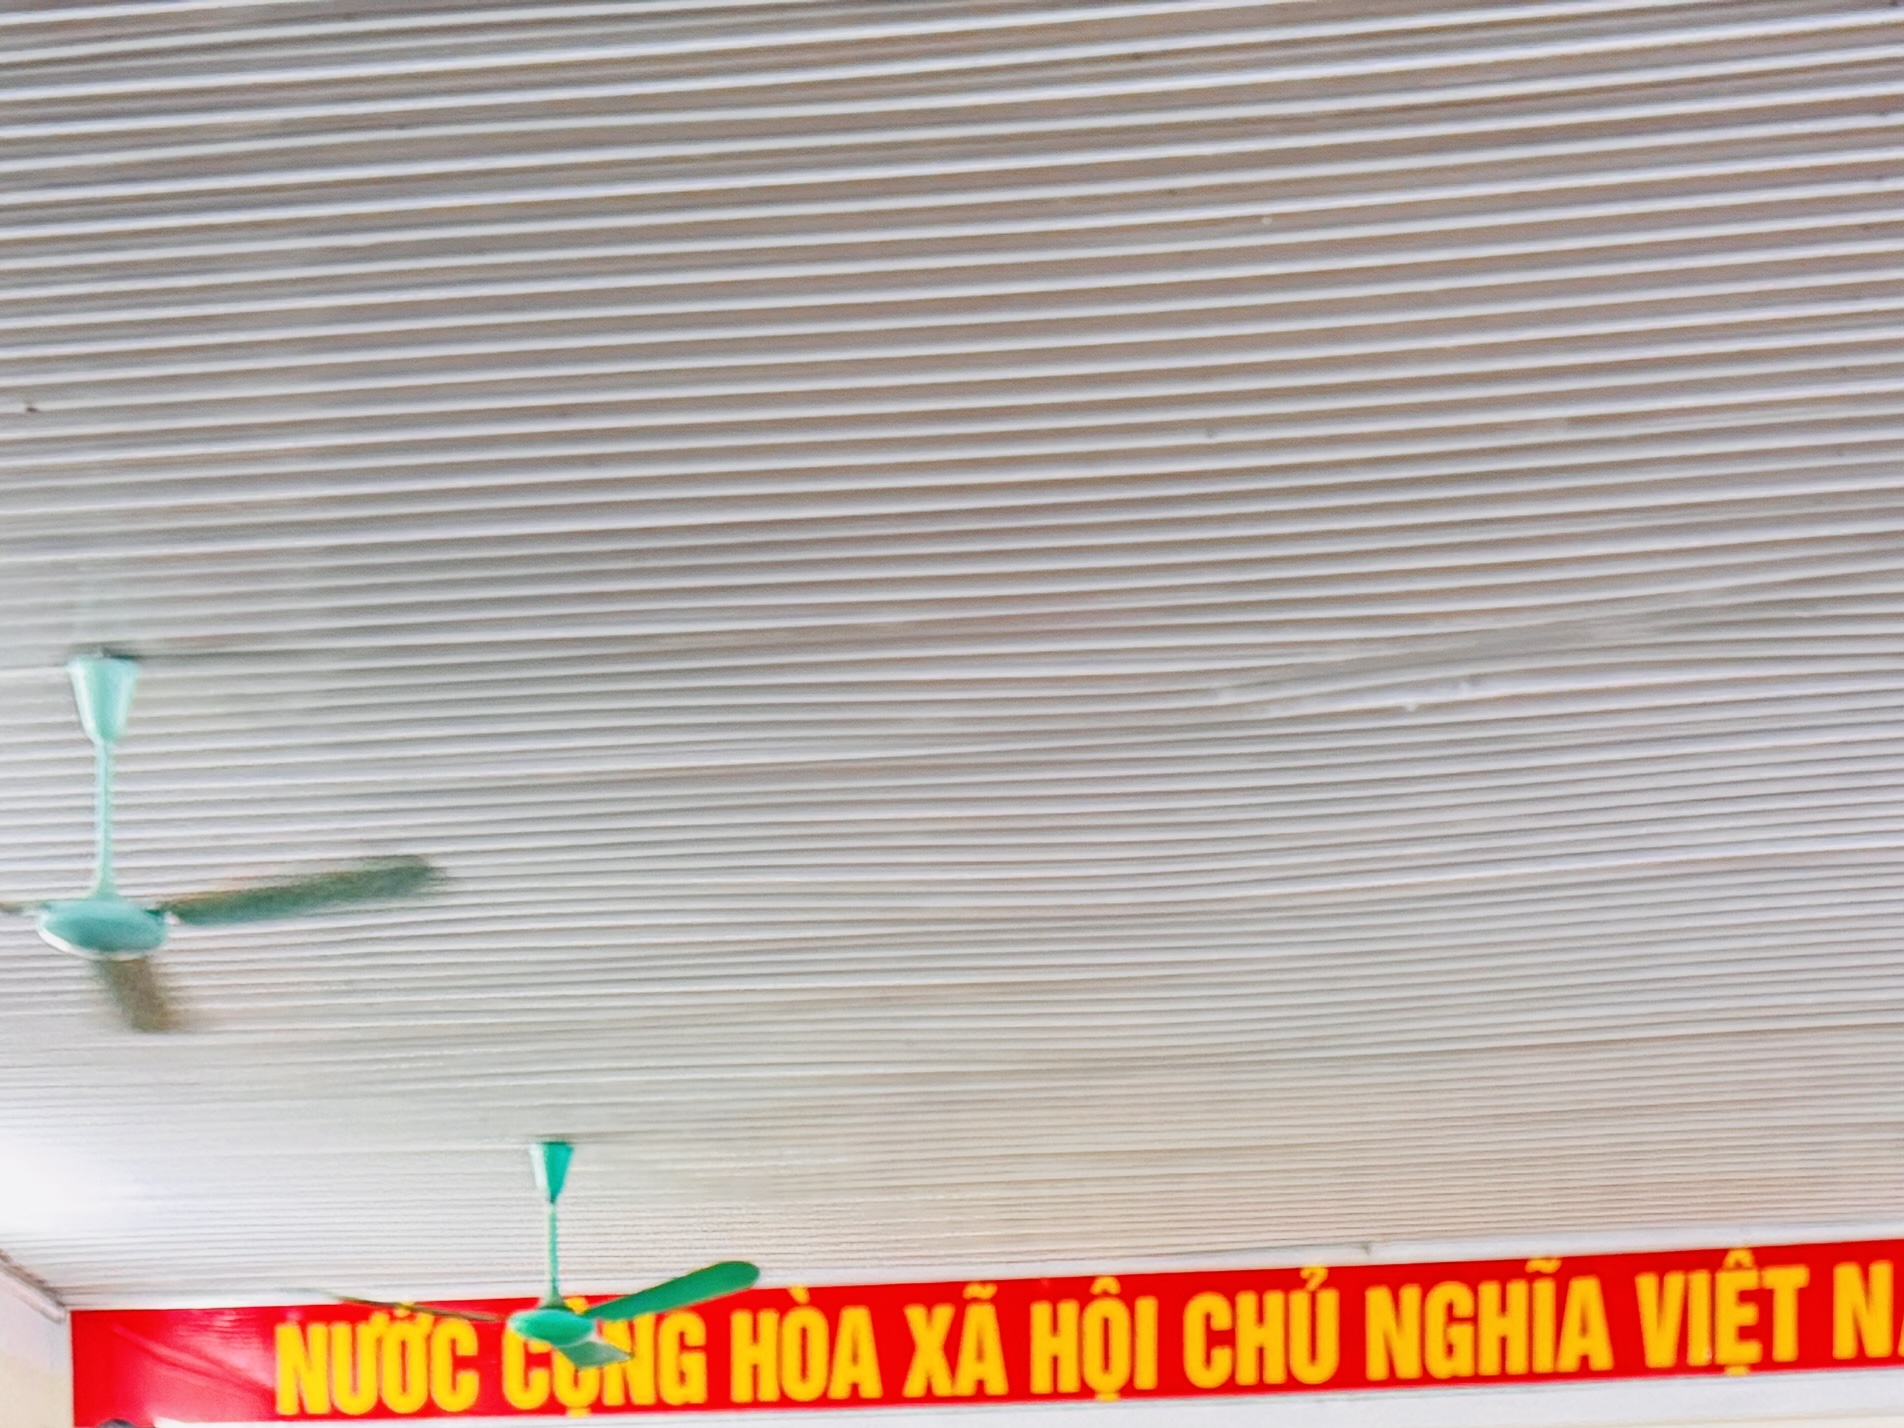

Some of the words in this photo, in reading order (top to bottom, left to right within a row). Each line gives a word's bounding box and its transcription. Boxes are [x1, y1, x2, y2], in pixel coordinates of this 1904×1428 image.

[273, 1301, 481, 1416] NƯỚC
[730, 1285, 883, 1403] HÒA
[903, 1283, 1008, 1398] XÃ
[1030, 1274, 1157, 1403] HỘI
[1184, 1265, 1339, 1388] CHỦ
[1365, 1255, 1613, 1380] NGHĨA
[1636, 1245, 1809, 1377] VIỆT
